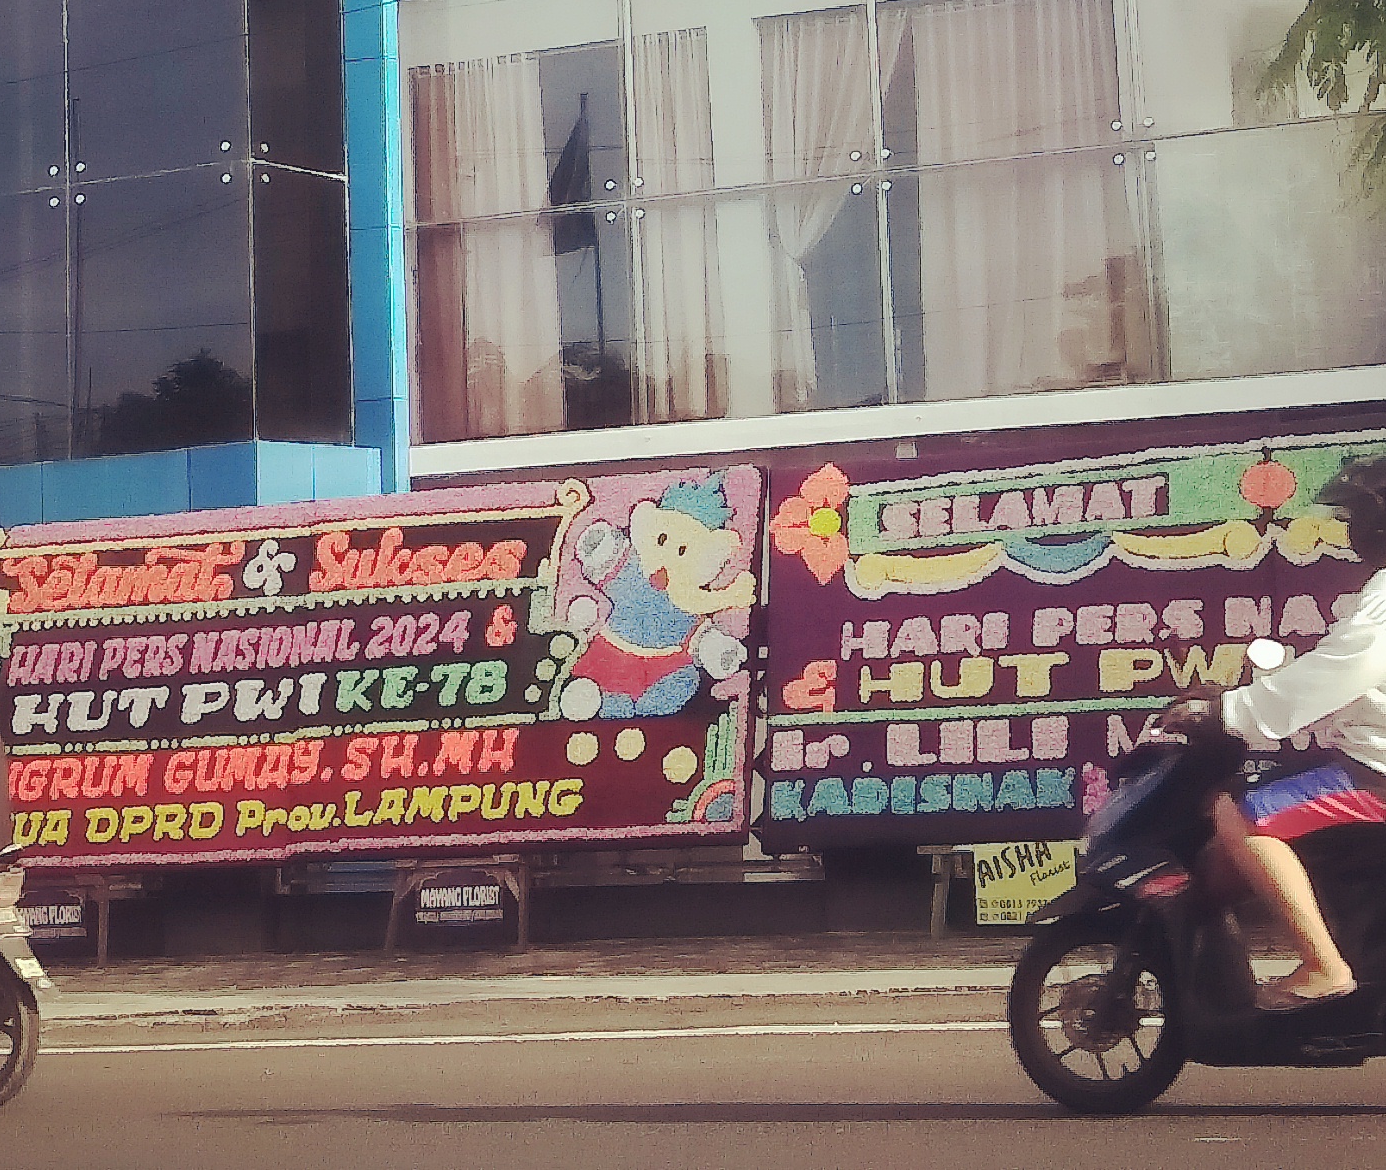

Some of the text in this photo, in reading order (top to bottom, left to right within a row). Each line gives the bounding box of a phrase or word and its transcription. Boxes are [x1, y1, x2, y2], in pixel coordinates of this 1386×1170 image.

[881, 475, 1167, 538] SELAMAT
[1, 526, 528, 614] Selamat & Sukses
[6, 603, 518, 687] HARI PERS NASIONAL 2024 &
[840, 610, 1011, 660] HARI
[1031, 598, 1204, 648] PERS
[11, 659, 510, 736] HUT PWI KE-78
[781, 658, 838, 713] &
[858, 652, 1071, 704] HUT
[886, 716, 1070, 766] LILI
[11, 808, 73, 847] UA
[84, 799, 226, 845] DPRD
[769, 767, 1075, 823] KADISNAK
[976, 841, 1053, 889] AISHA
[420, 884, 501, 909] MAYANG FLORIST
